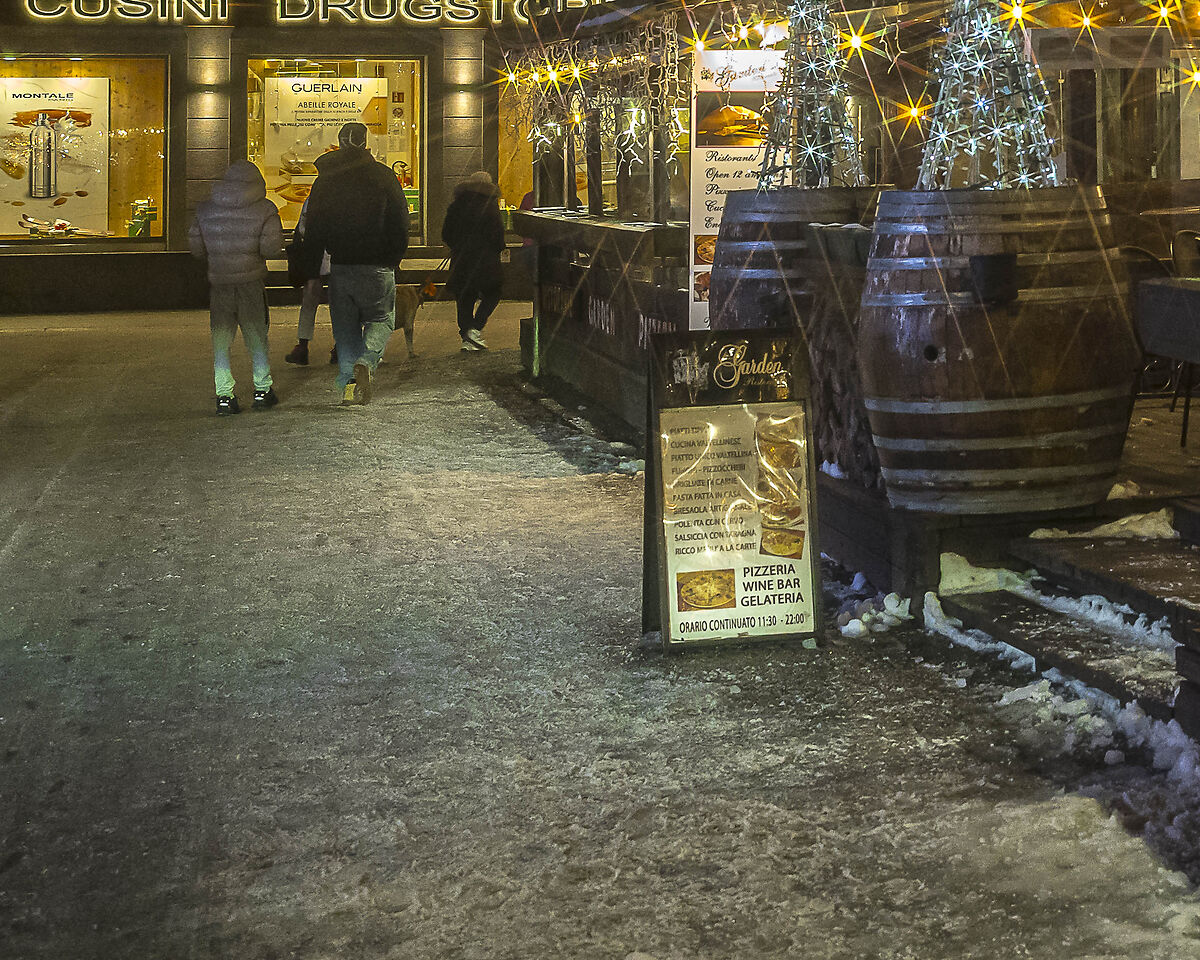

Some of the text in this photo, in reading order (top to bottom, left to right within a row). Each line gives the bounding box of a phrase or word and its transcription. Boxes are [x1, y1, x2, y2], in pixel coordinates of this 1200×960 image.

[291, 83, 362, 93] GUERLAIN
[705, 167, 729, 182] Open
[732, 170, 743, 178] 12
[714, 343, 783, 389] Garden
[672, 493, 694, 501] PASTA
[694, 492, 714, 500] FATTA
[705, 518, 721, 526] CON
[721, 517, 744, 525] CRVO
[674, 531, 708, 542] SALSICCIA
[709, 530, 725, 539] CON
[675, 546, 696, 556] RICCO
[719, 544, 725, 552] A
[735, 542, 757, 551] CARTE
[743, 563, 796, 578] PIZZERIA
[742, 578, 801, 592] WINE BAR
[741, 592, 805, 607] GELATERIA
[679, 620, 708, 634] ORARIO
[708, 616, 756, 631] CONTINUATO
[757, 615, 777, 627] 11:30
[785, 613, 805, 625] 22:00
